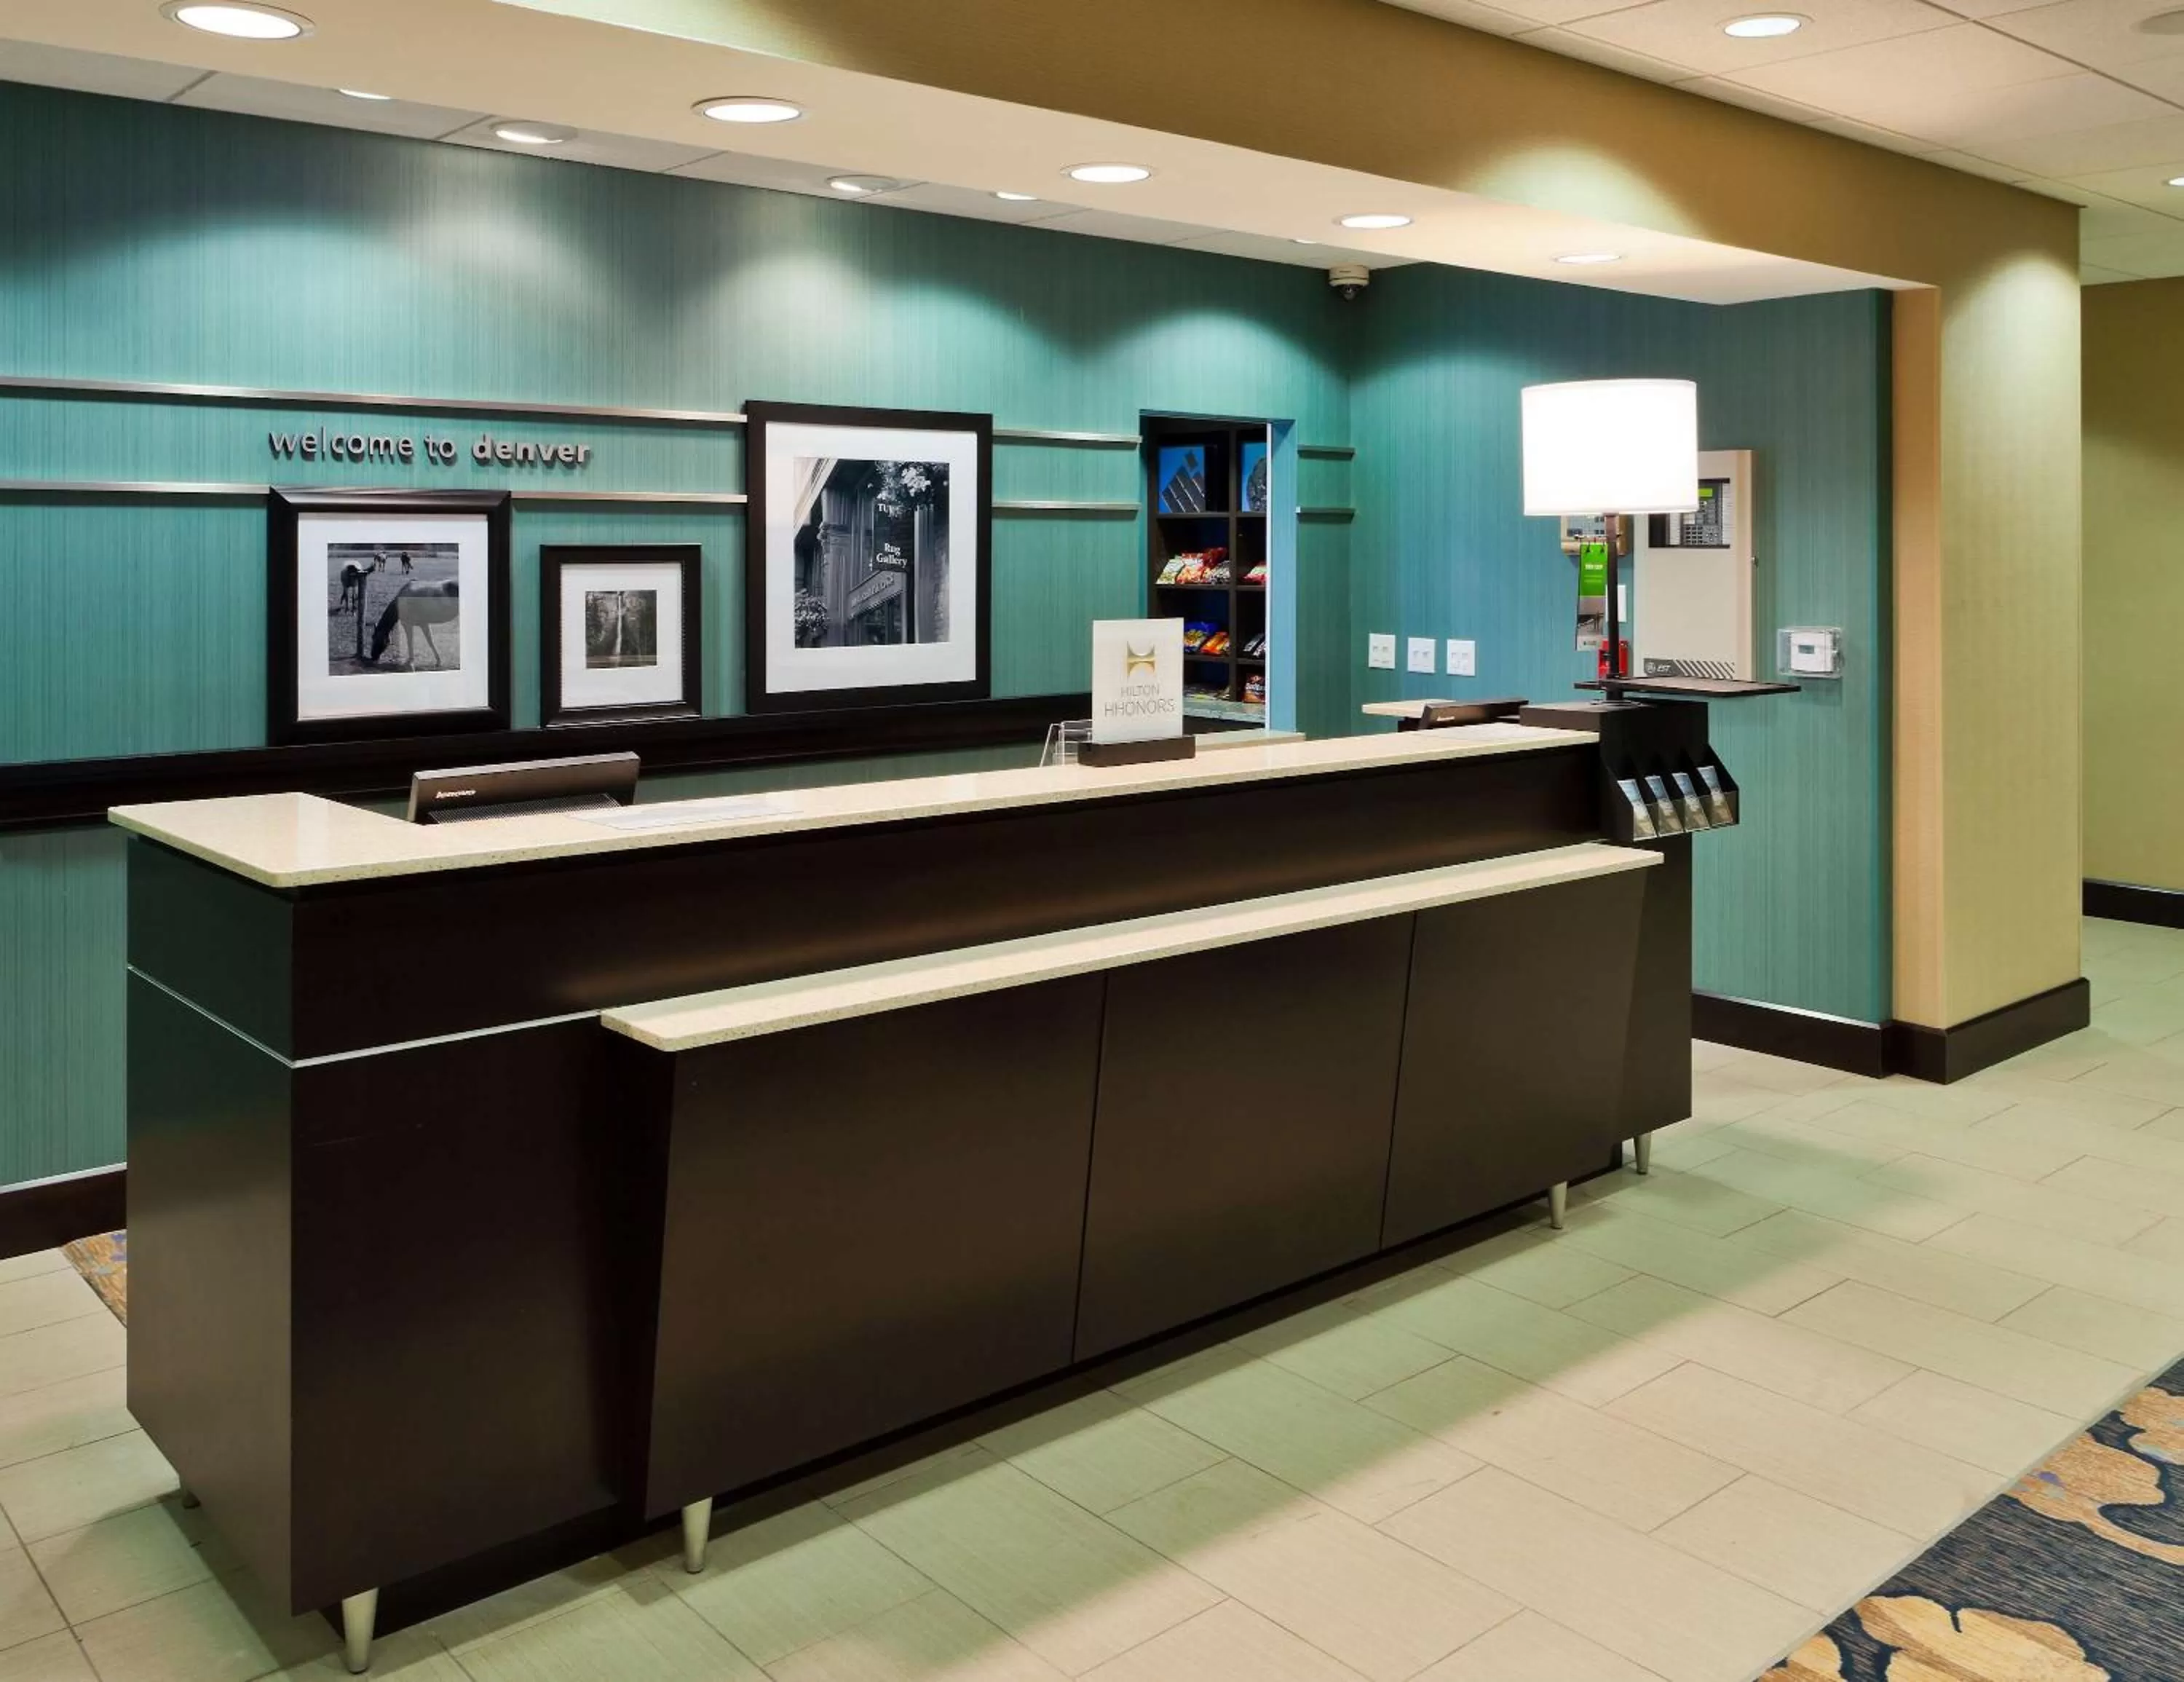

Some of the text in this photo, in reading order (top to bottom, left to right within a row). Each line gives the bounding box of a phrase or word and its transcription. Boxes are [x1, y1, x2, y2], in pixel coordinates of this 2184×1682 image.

[269, 426, 590, 464] welcome to denver
[1121, 684, 1160, 698] HILTON
[1104, 699, 1175, 717] HHONORS
